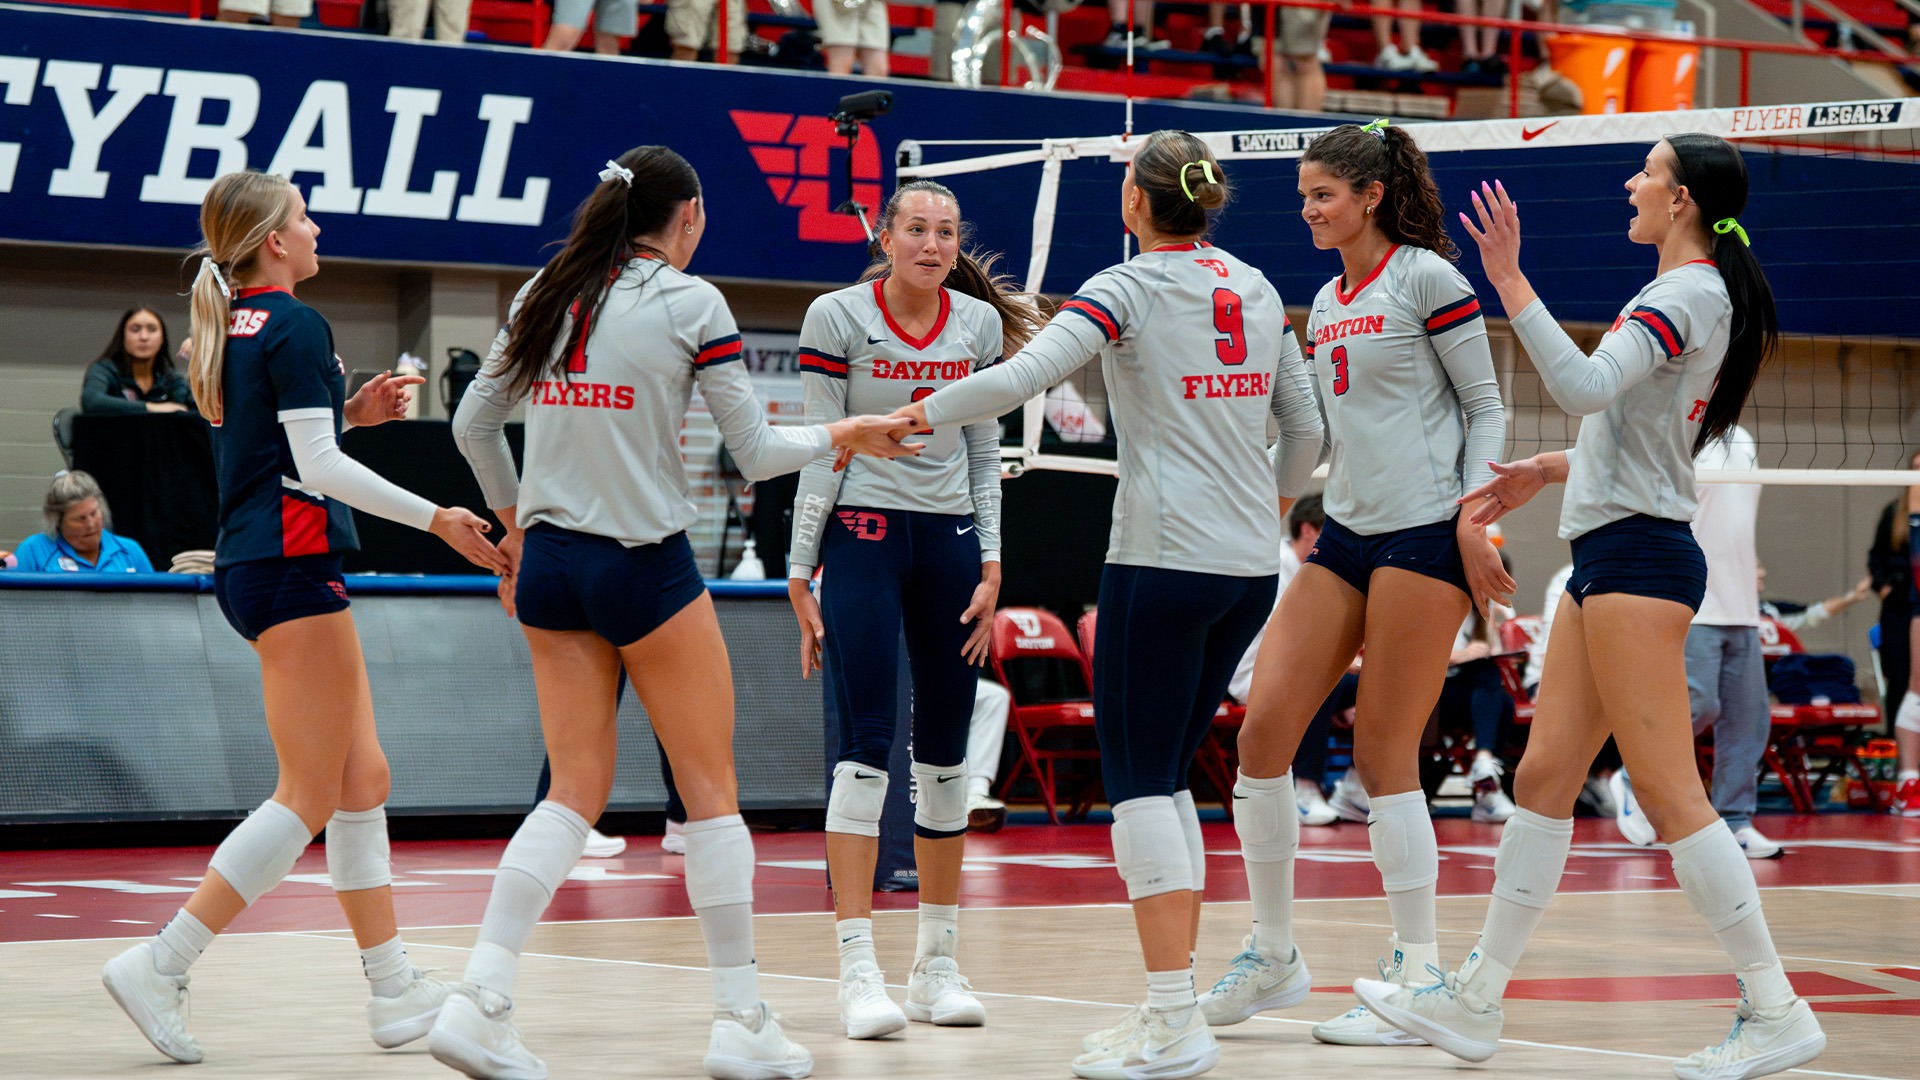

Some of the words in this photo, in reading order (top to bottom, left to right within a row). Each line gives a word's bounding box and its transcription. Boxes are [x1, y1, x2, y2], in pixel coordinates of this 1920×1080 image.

[1731, 107, 1802, 132] FLYER
[1814, 103, 1896, 126] LEGACY
[1238, 132, 1299, 151] DAYTON
[1211, 287, 1248, 366] 9
[1314, 314, 1385, 347] DAYTON
[871, 359, 970, 380] DAYTON
[1331, 344, 1350, 397] 3
[531, 381, 635, 410] FLYERS
[1180, 372, 1271, 400] FLYERS
[796, 493, 827, 548] FLYER
